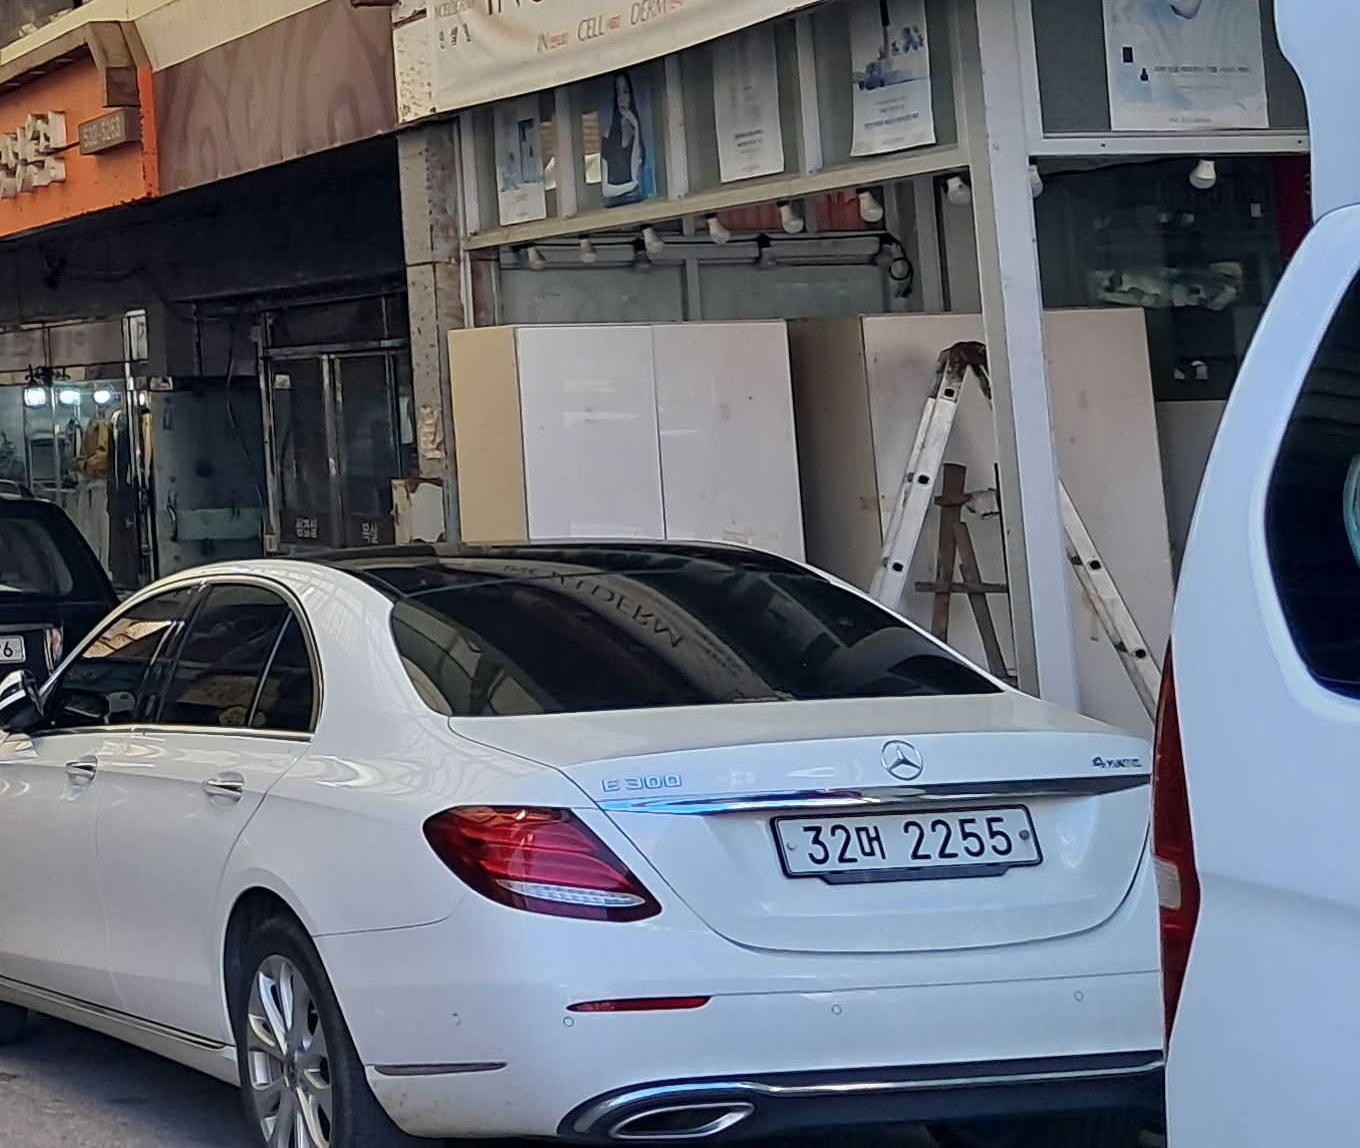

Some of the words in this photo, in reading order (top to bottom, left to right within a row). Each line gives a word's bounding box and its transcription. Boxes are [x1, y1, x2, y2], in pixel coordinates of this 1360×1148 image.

[577, 14, 604, 42] CELL
[601, 778, 621, 792] E
[624, 773, 684, 792] 300
[806, 823, 883, 866] 32머
[902, 815, 1013, 862] 2255
